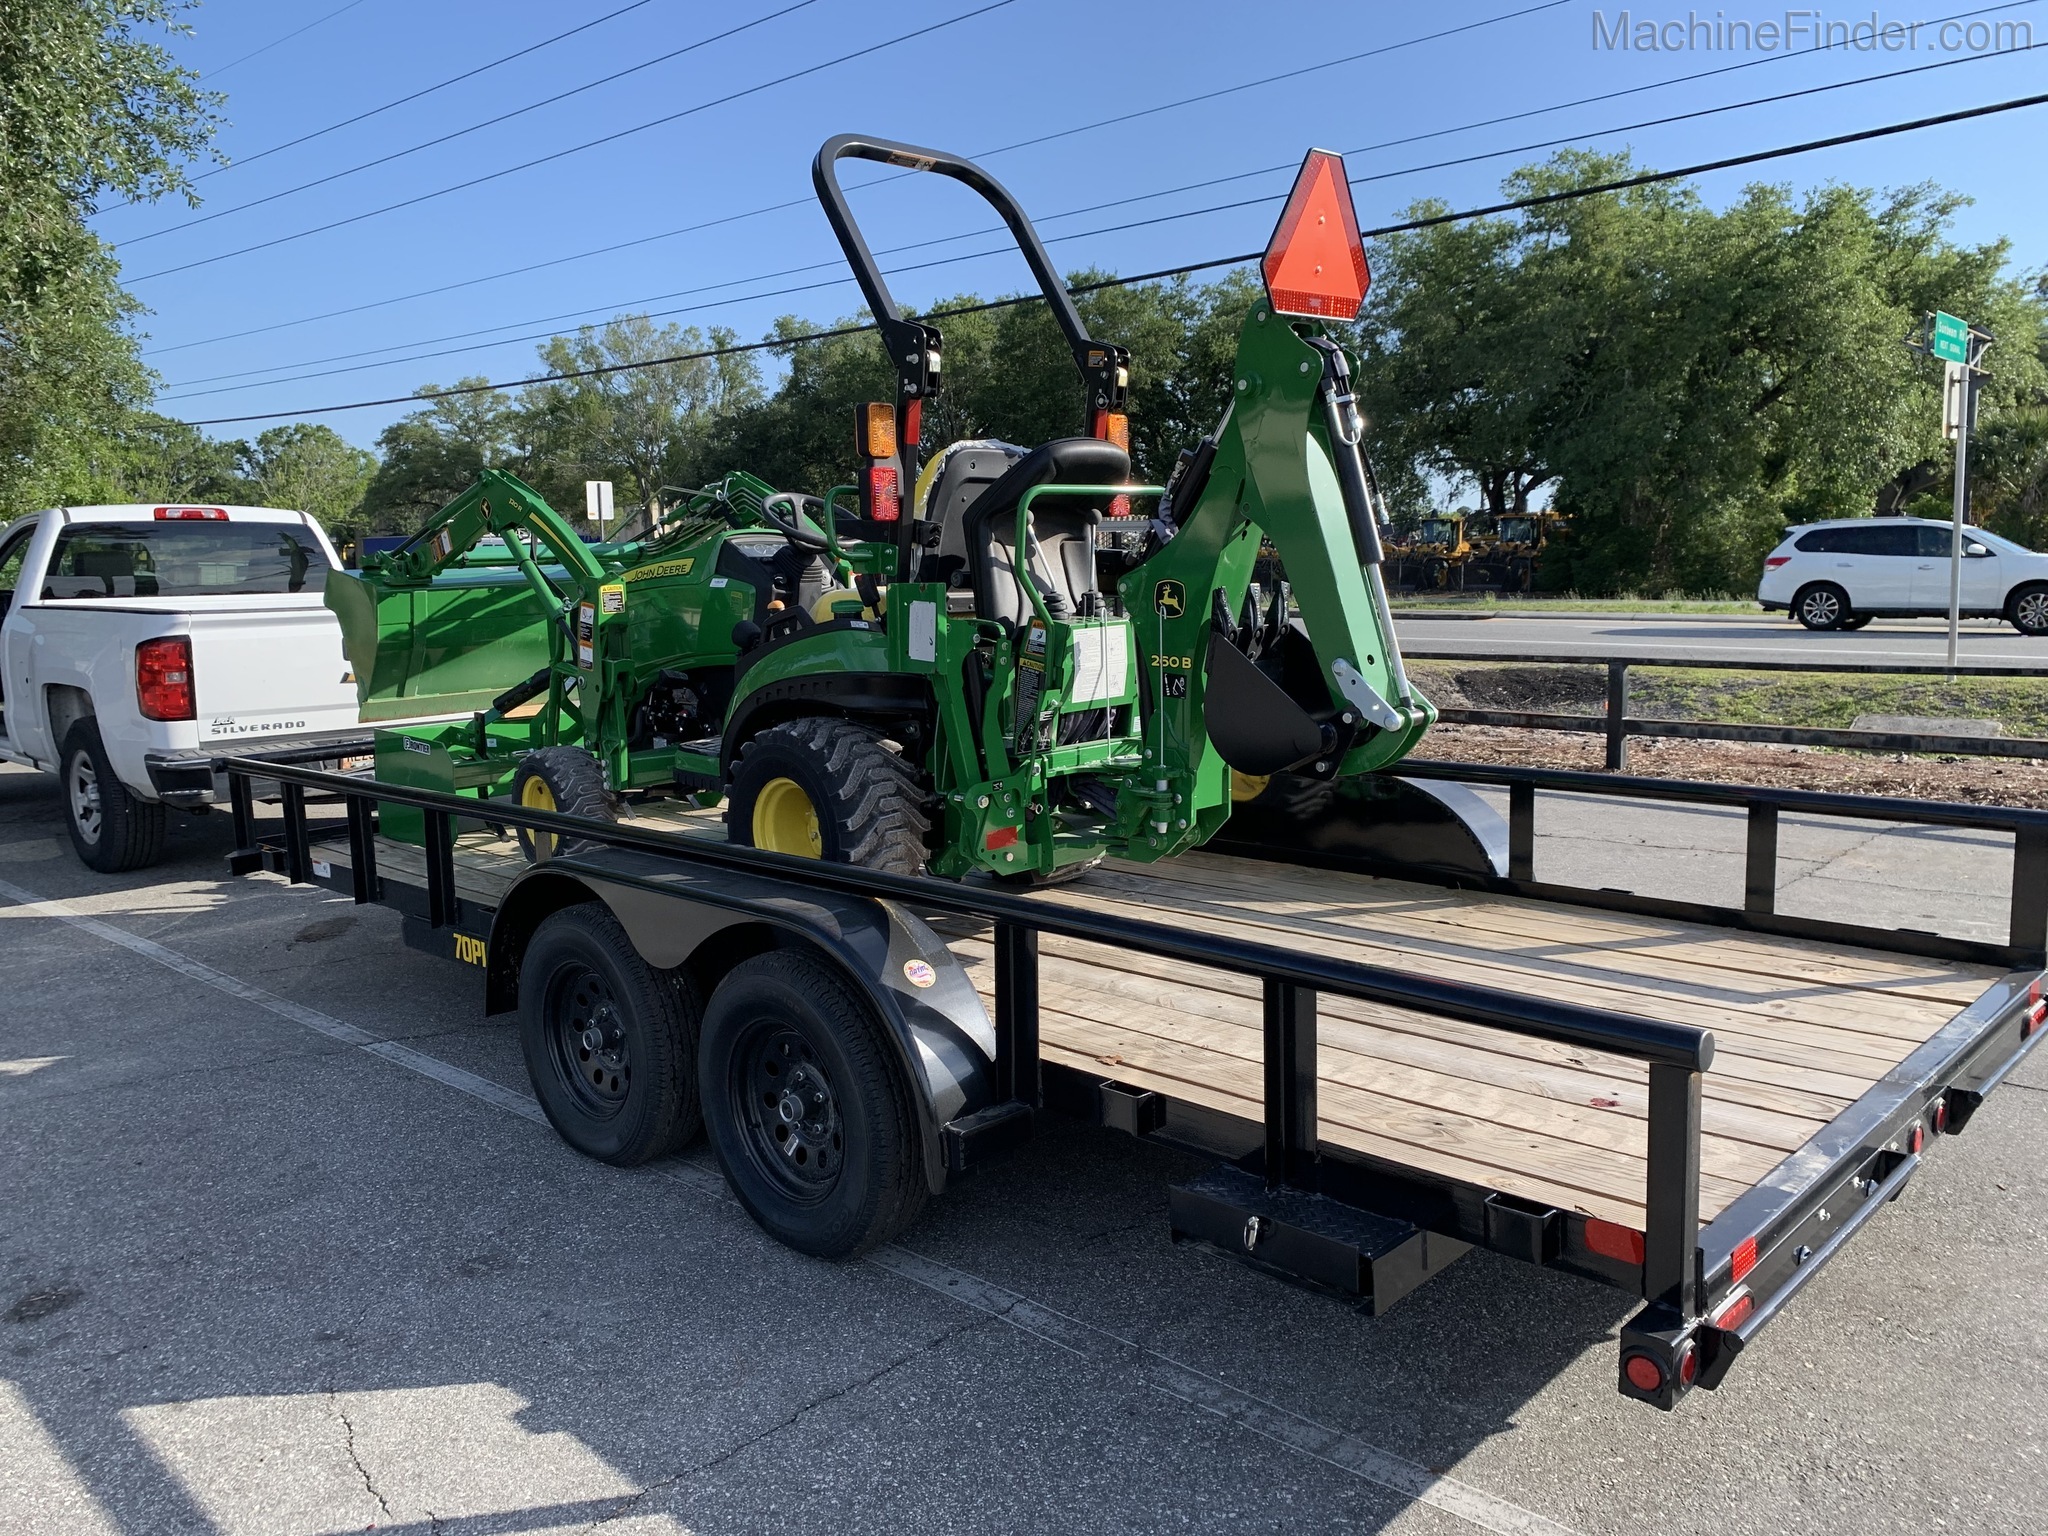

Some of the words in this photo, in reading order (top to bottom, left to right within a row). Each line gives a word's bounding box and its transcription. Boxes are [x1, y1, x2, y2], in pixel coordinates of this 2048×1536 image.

[631, 568, 656, 582] JOHN
[656, 564, 688, 577] DEERE
[1151, 655, 1180, 668] 260
[1182, 657, 1192, 669] B
[211, 721, 305, 735] SILVERADO
[453, 932, 487, 968] 70PI
